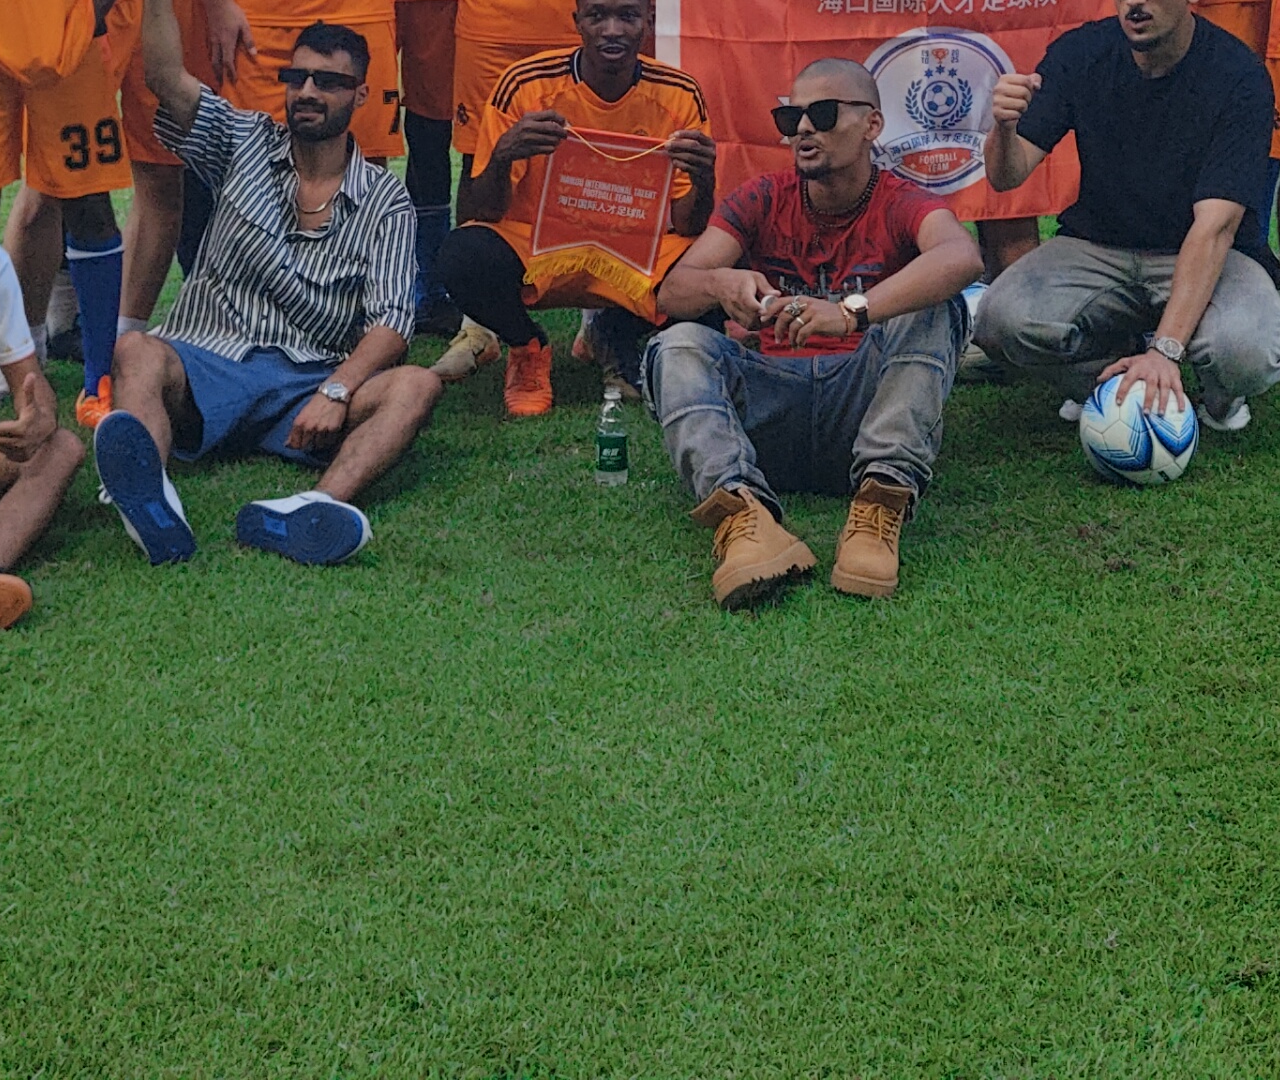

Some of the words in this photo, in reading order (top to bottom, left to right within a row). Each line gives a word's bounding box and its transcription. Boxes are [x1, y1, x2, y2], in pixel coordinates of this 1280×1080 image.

[60, 116, 122, 171] 39
[889, 132, 982, 156] 海口国际人才足球队
[919, 152, 958, 164] FOOTBALL
[927, 162, 950, 172] TEAM
[557, 194, 646, 220] 海口国际人才足球队
